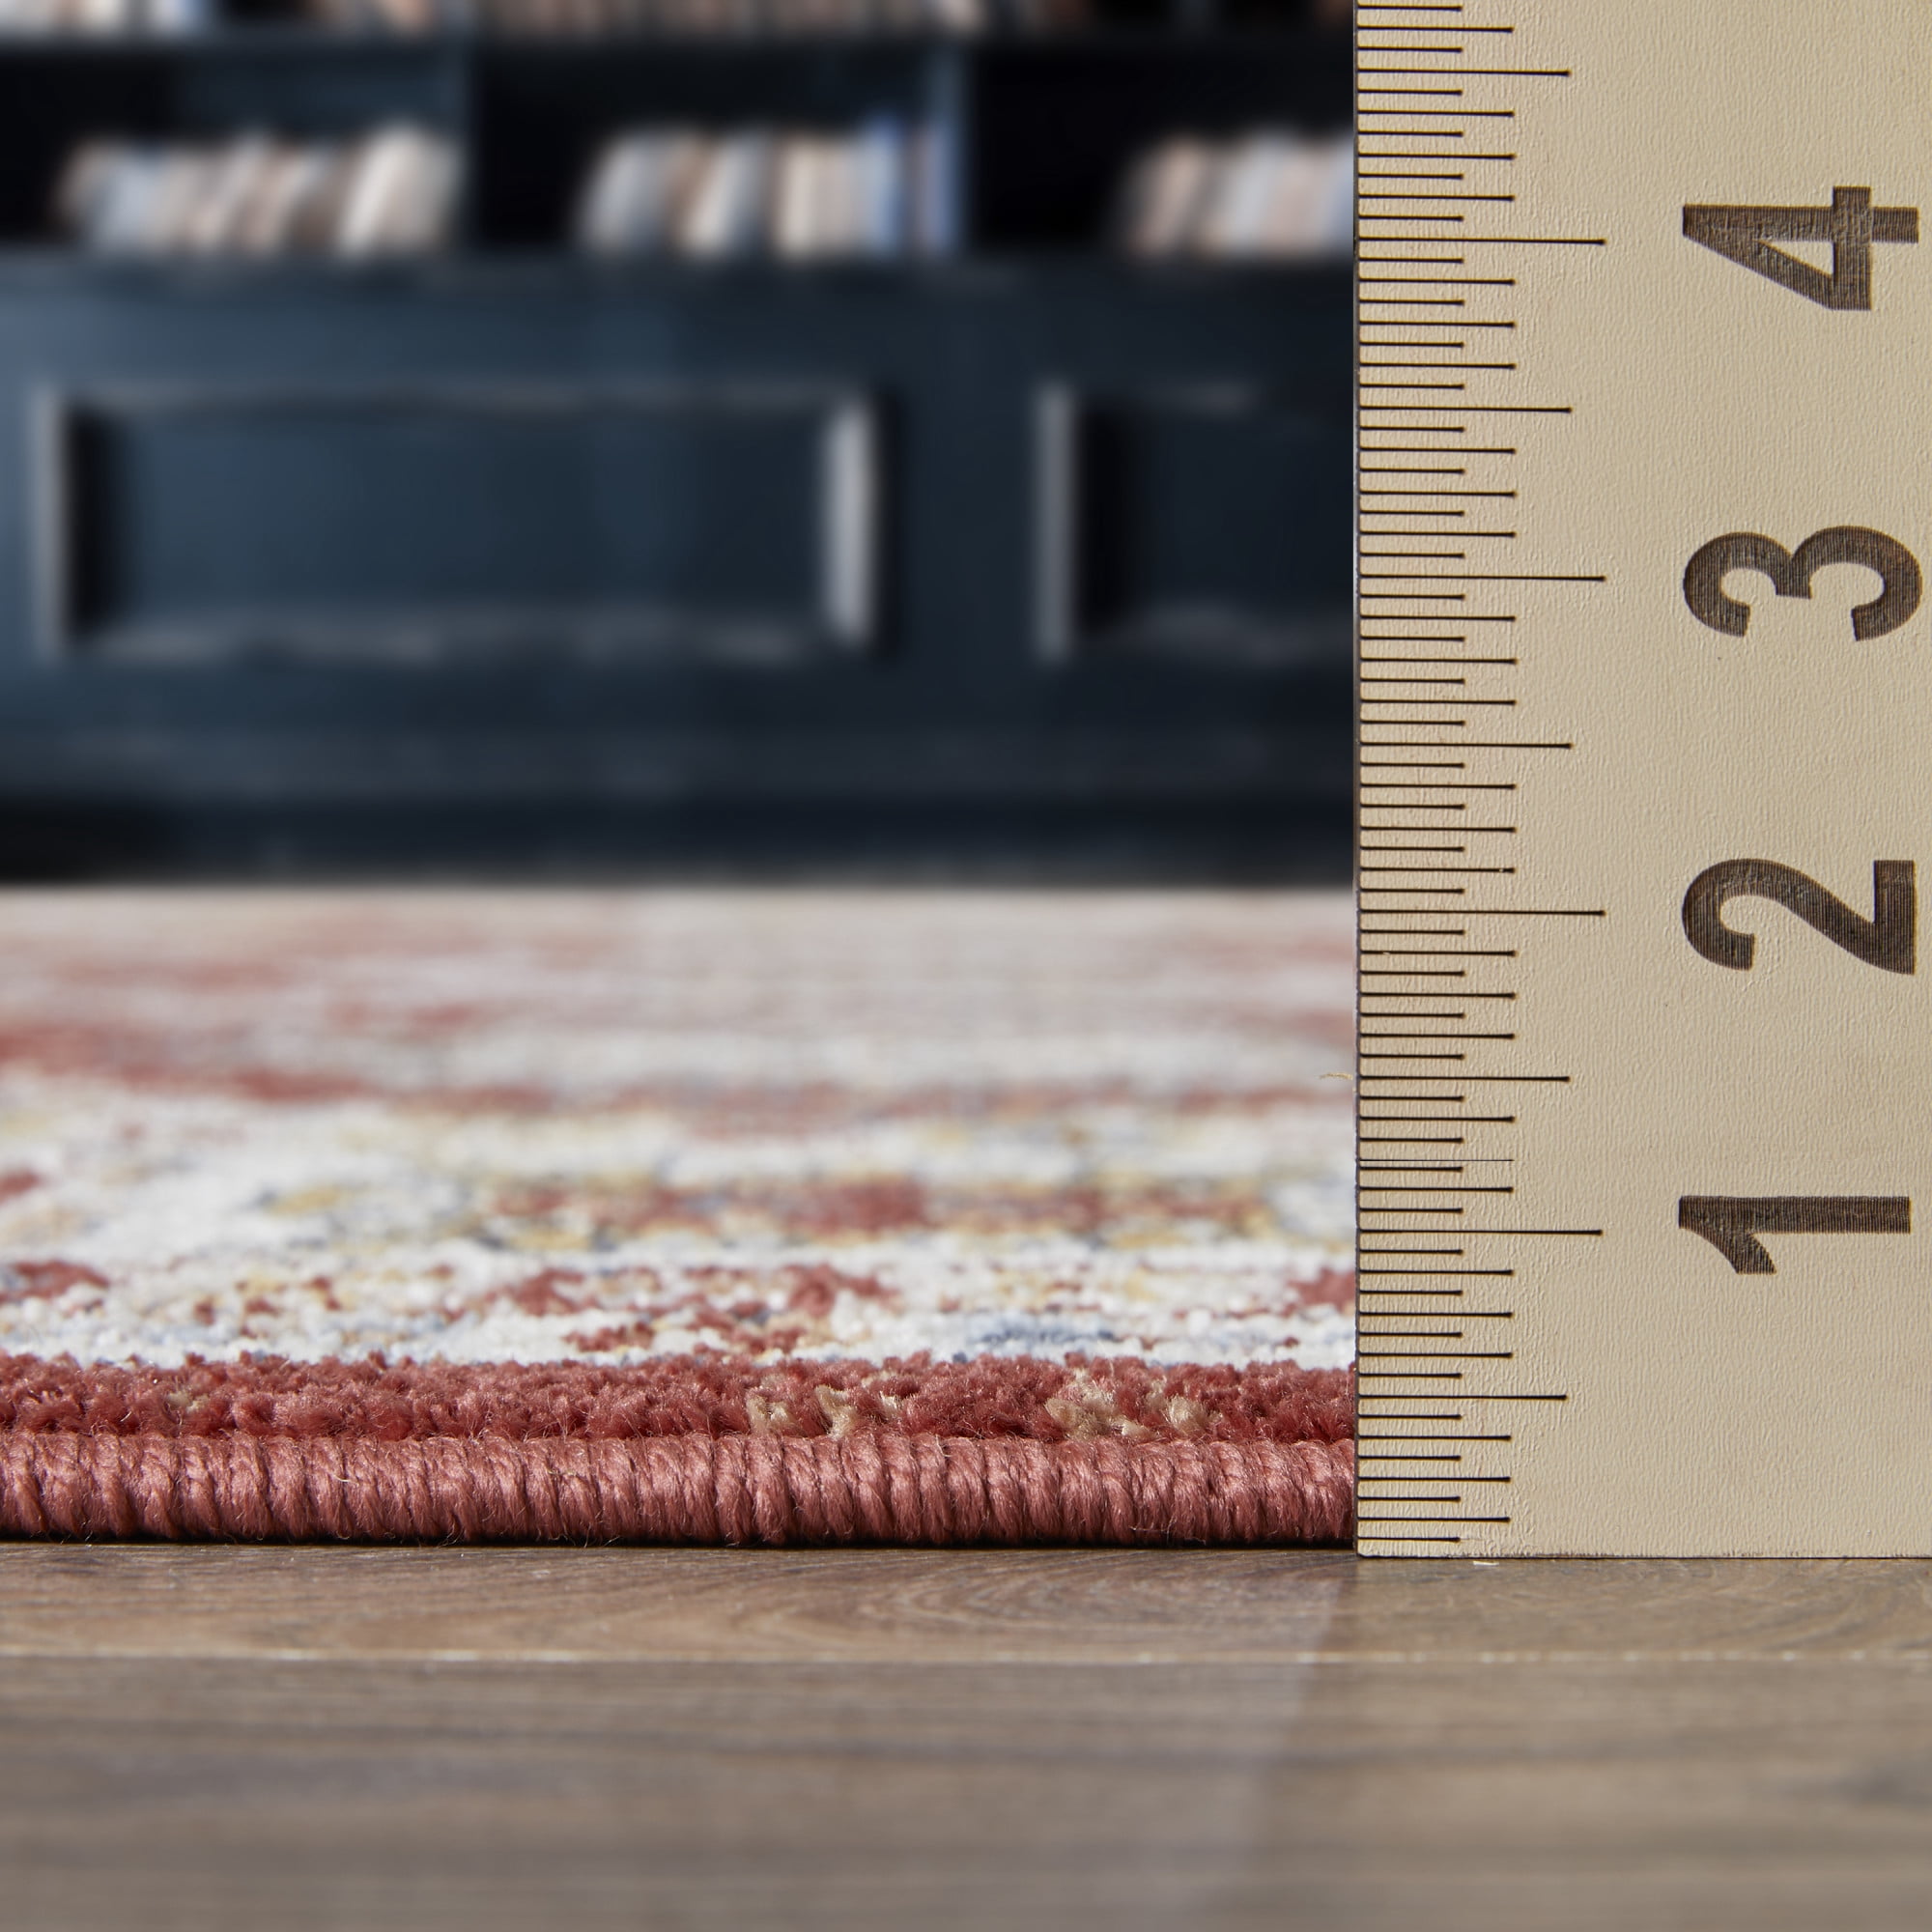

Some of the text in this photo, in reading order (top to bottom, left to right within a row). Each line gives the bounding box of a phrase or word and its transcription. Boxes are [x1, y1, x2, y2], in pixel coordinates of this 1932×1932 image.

[1683, 186, 1919, 311] 4
[1683, 526, 1922, 641] 3
[1682, 858, 1917, 976] 2
[1678, 1196, 1912, 1275] 1
